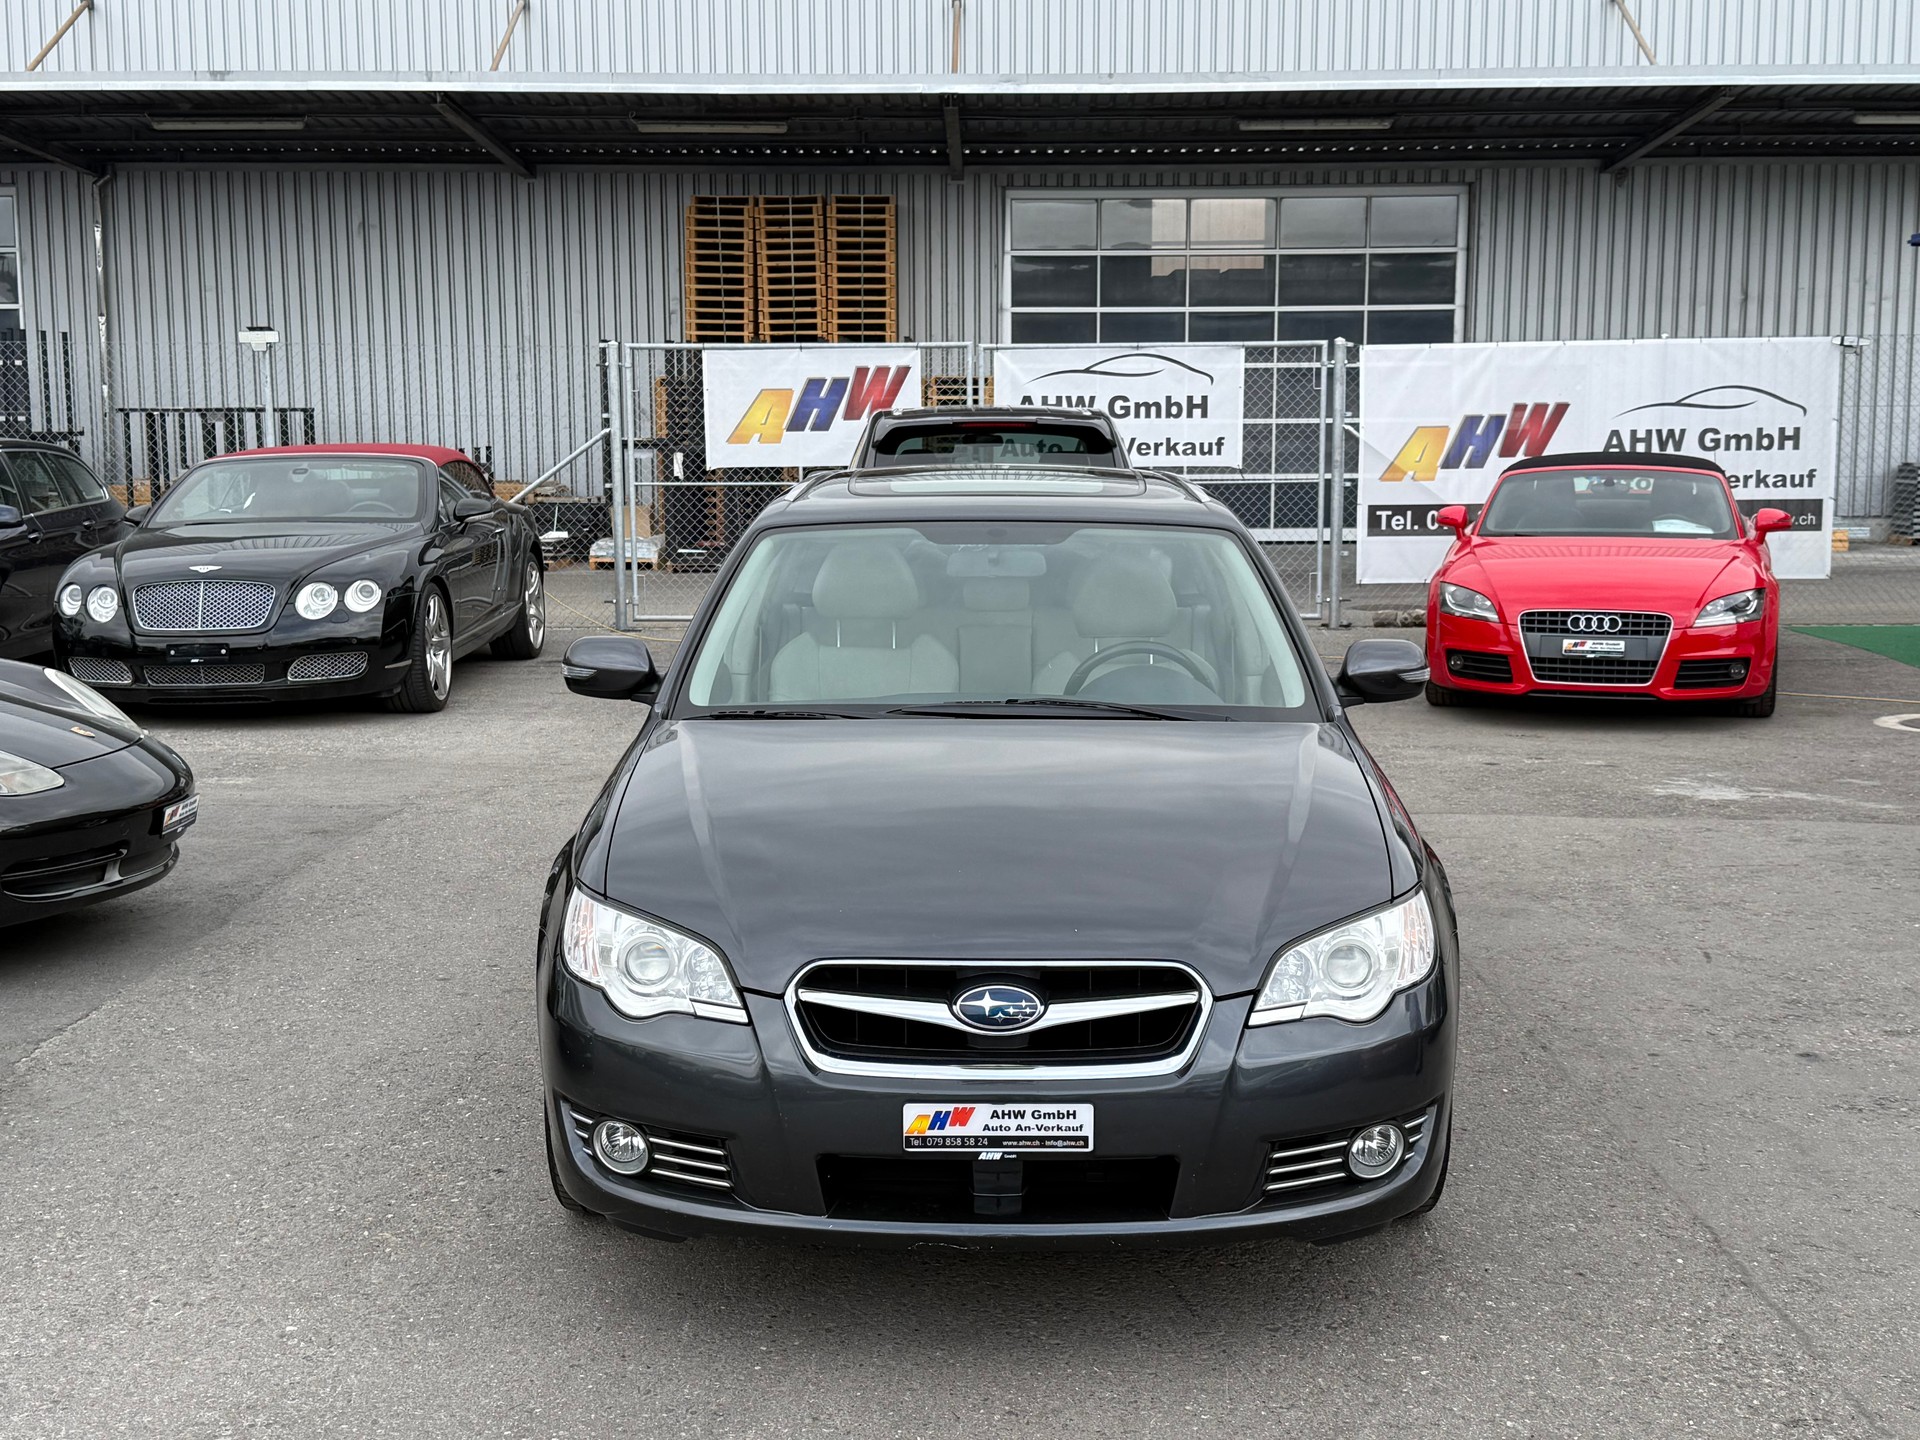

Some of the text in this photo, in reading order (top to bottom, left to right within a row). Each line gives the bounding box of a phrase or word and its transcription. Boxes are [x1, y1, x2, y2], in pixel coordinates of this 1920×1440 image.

[725, 365, 911, 444] AHW
[1108, 395, 1209, 419] GmbH
[1378, 402, 1571, 482] AHW
[1603, 427, 1800, 452] AHW GmbH
[1376, 510, 1419, 530] Tel.
[905, 1107, 976, 1134] AHW
[990, 1109, 1077, 1120] AHW GmbH
[982, 1123, 1084, 1132] Auto An-Verkauf
[910, 1138, 988, 1146] Tel. 079 858 58 24
[978, 1152, 1003, 1160] AHW
